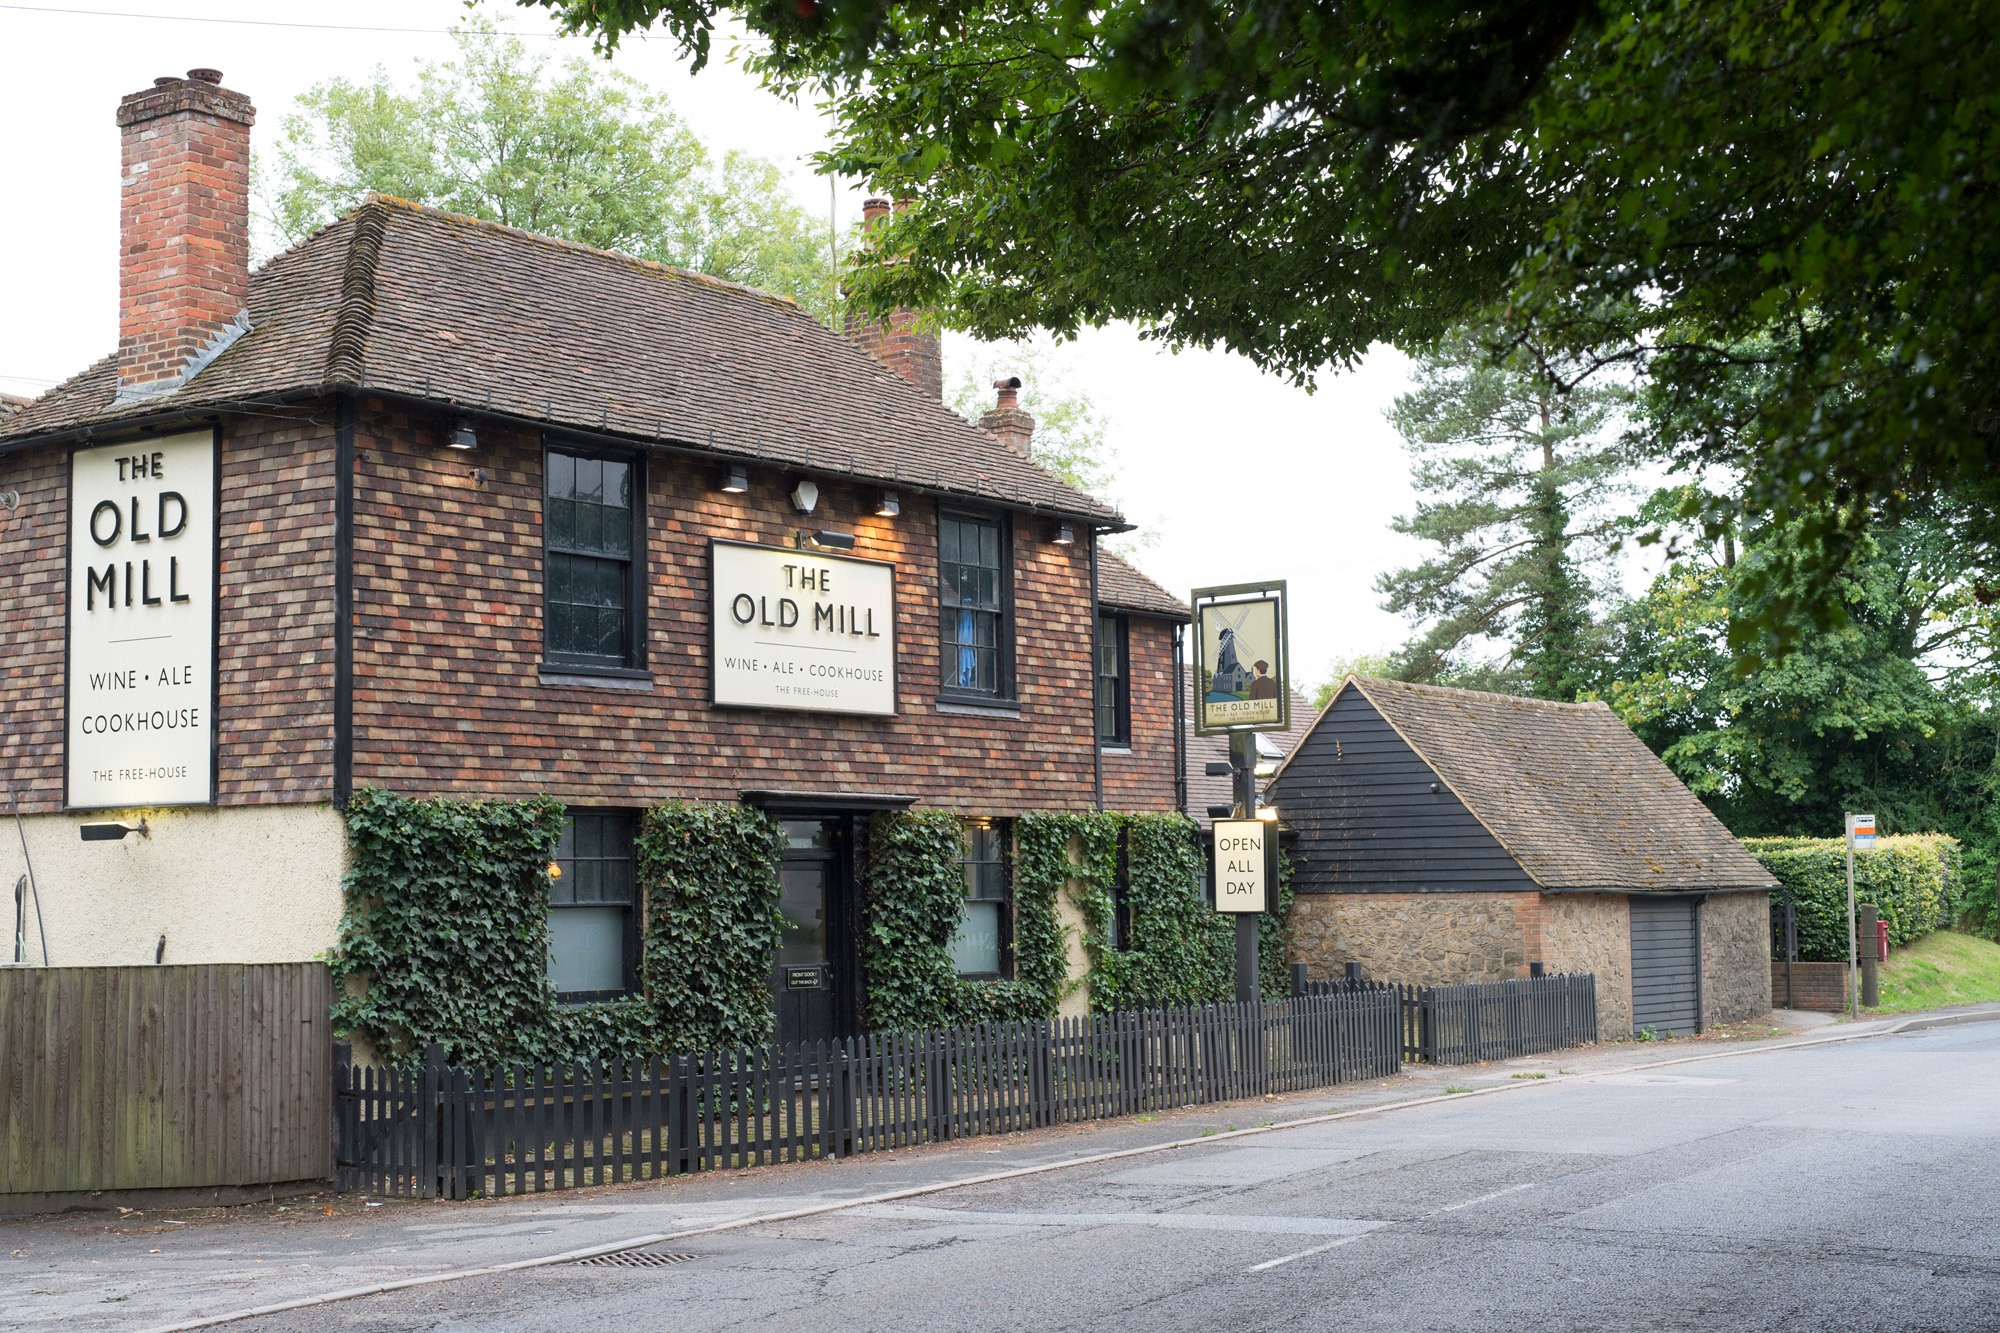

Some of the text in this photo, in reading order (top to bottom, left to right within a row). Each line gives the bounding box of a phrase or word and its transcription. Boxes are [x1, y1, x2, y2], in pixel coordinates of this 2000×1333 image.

[115, 452, 164, 482] THE
[90, 491, 189, 548] OLD
[87, 556, 190, 611] MILL
[784, 564, 831, 592] THE
[731, 593, 880, 637] OLD MILL
[89, 666, 192, 691] WINE ALE
[724, 657, 883, 682] WINE ALE COOKHOUSE
[775, 685, 839, 698] THE FREE-HOUSE
[1210, 701, 1274, 712] THE OLD MILL
[82, 708, 199, 734] COOKHOUSE
[93, 766, 187, 782] THE FREE-HOUSE
[1219, 838, 1261, 851] OPEN
[1227, 860, 1254, 873] ALL
[1226, 882, 1256, 895] DAY
